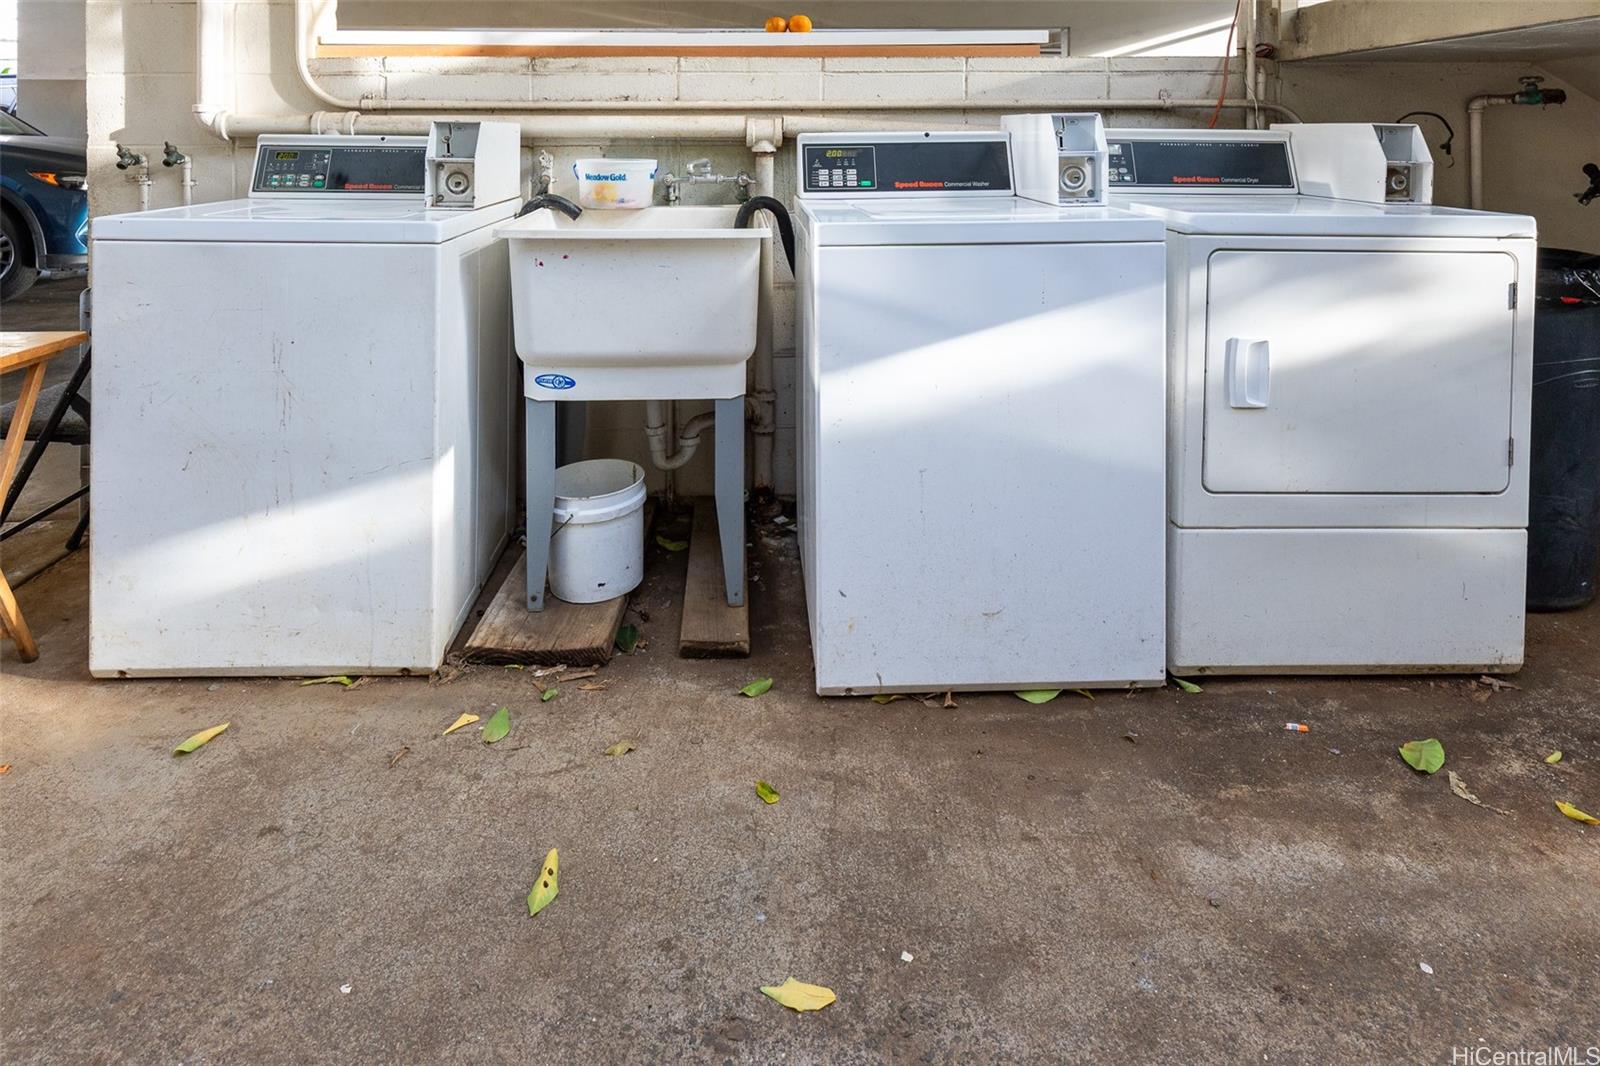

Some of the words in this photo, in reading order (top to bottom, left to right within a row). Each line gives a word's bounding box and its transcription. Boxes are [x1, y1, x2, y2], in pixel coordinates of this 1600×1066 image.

[609, 173, 626, 181] Gold
[1173, 176, 1196, 184] Speed
[345, 183, 369, 191] Speed
[895, 181, 918, 189] Speed
